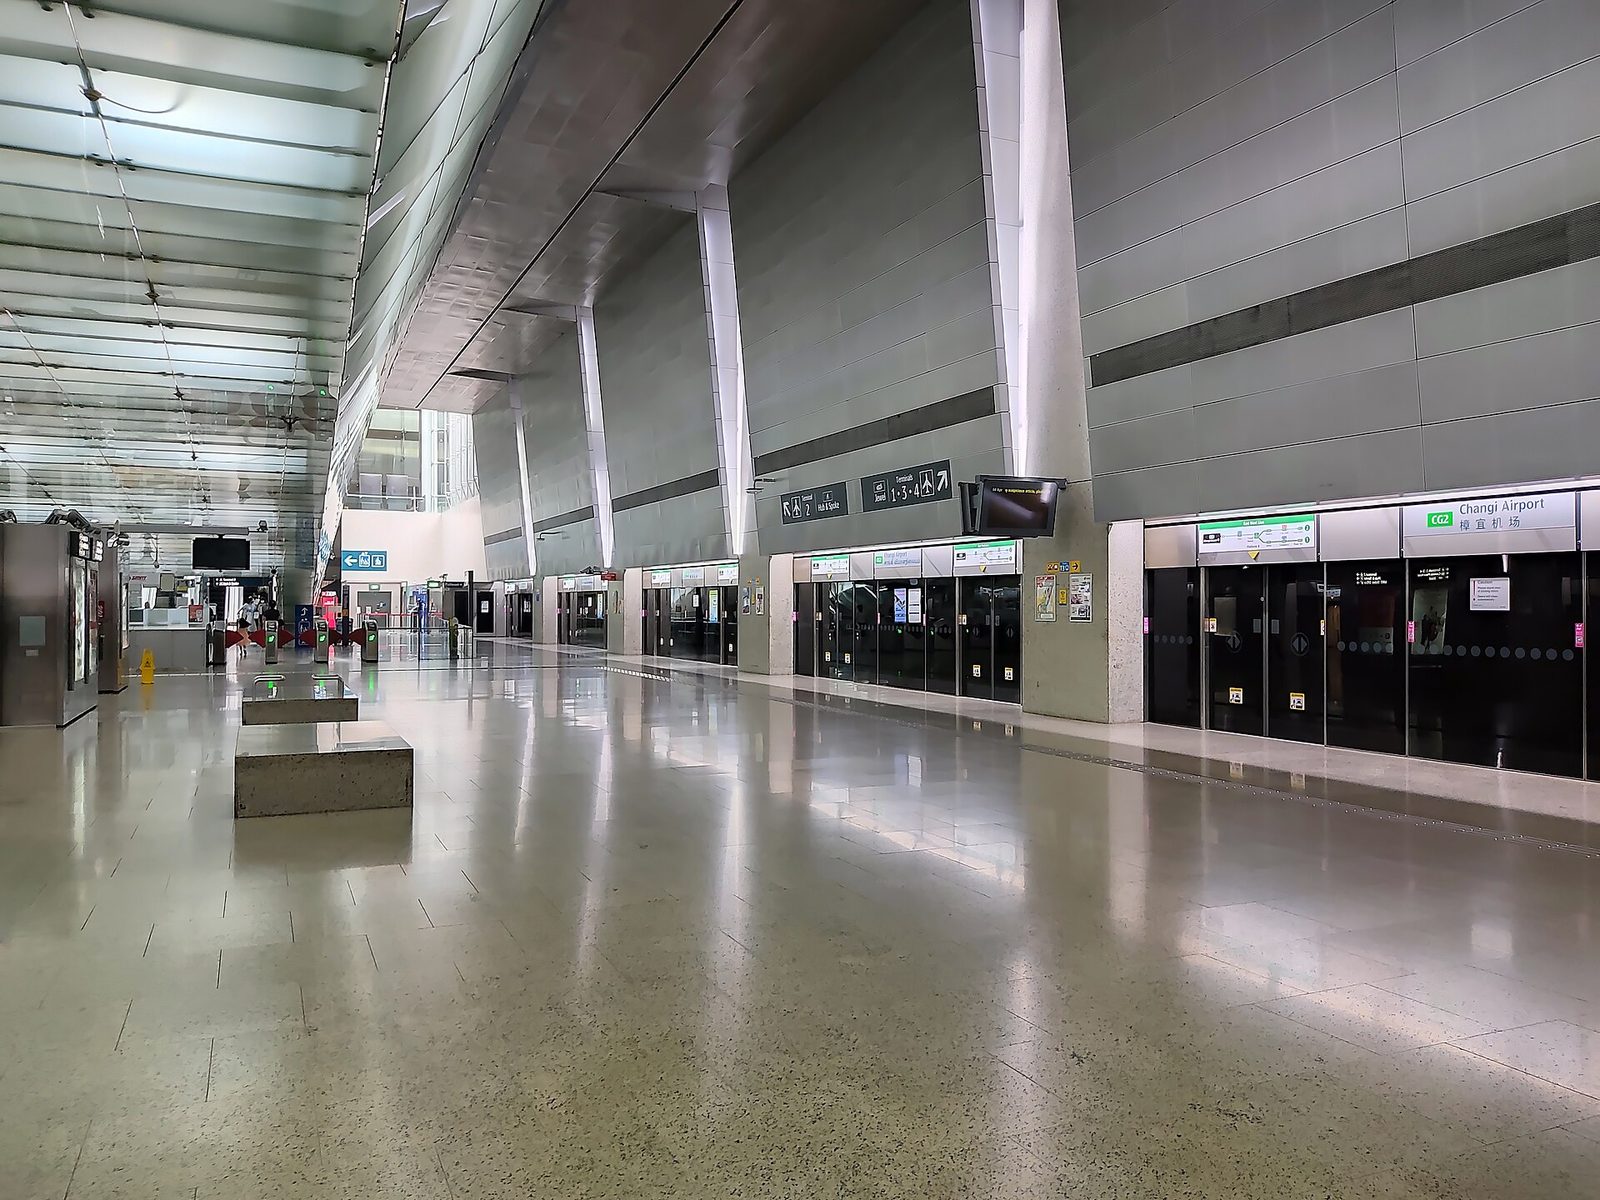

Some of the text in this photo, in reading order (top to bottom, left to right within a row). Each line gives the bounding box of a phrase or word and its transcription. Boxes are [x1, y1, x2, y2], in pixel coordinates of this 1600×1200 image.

[805, 503, 811, 517] 2
[1459, 498, 1545, 515] Changi Airport
[1431, 514, 1449, 525] CG2
[1459, 516, 1520, 531] 樟宜机场
